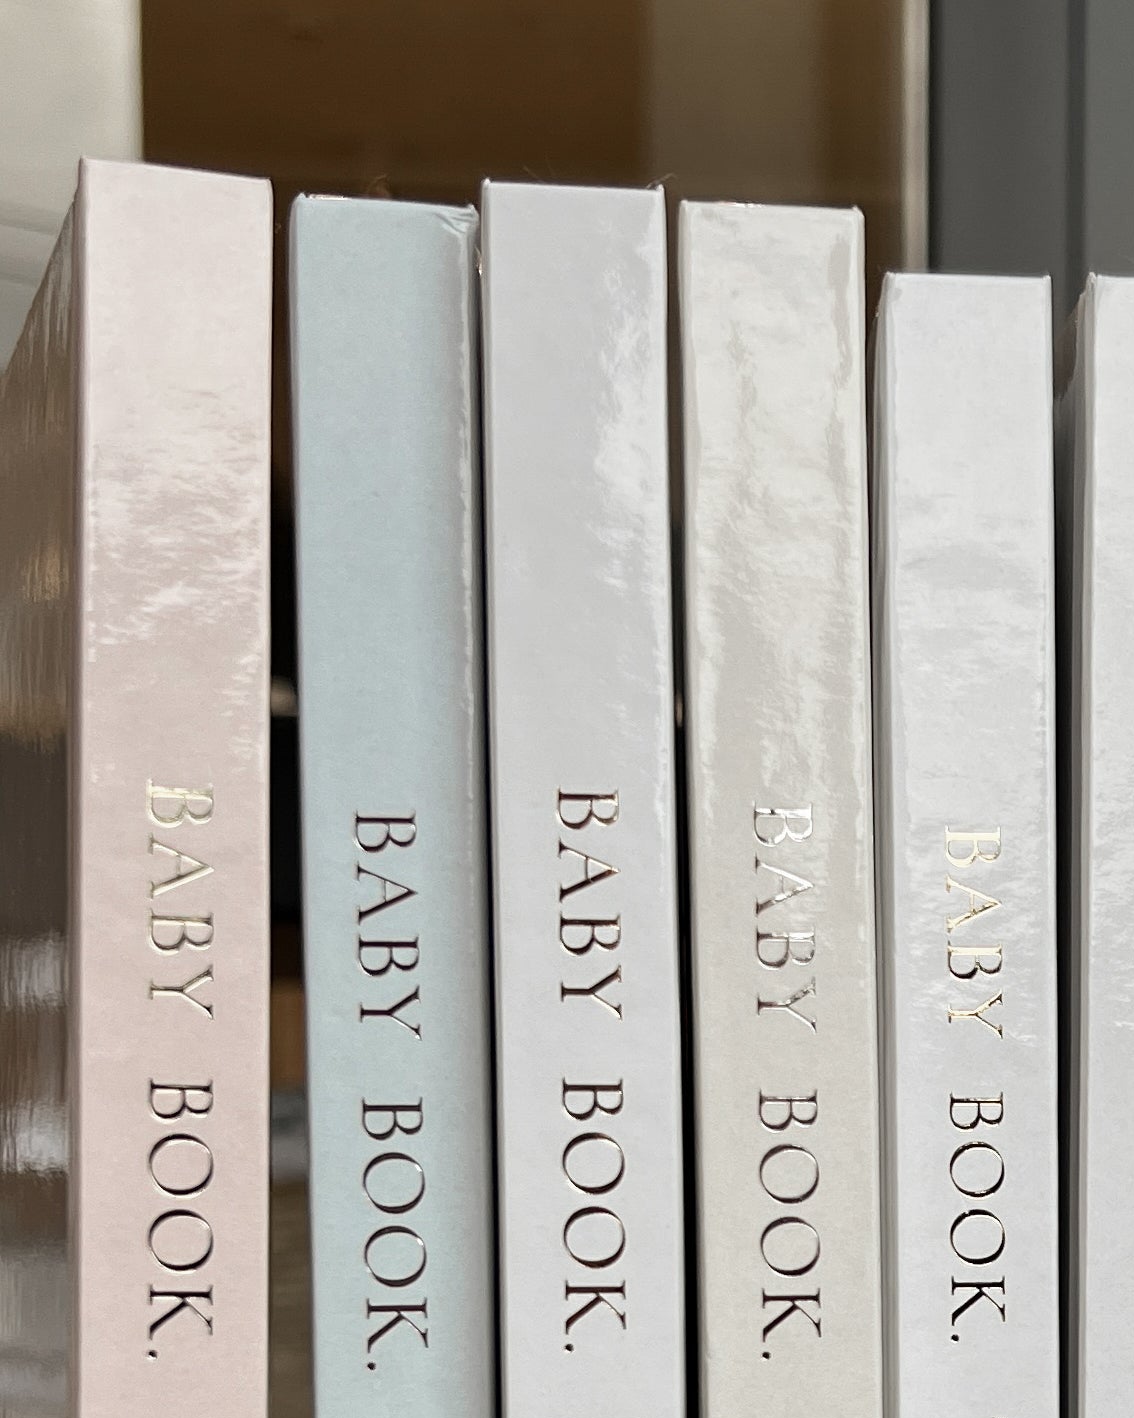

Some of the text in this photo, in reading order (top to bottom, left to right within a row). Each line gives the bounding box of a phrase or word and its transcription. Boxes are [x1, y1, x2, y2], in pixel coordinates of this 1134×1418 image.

[146, 778, 214, 1020] BABY
[353, 810, 422, 1040] BABY
[556, 786, 623, 1021] BABY
[752, 801, 817, 1034] BABY
[944, 825, 1004, 1040] BABY
[147, 1078, 214, 1360] BOOK.
[361, 1098, 429, 1371] BOOK.
[561, 1077, 627, 1352] BOOK.
[758, 1089, 822, 1360] BOOK.
[949, 1092, 1006, 1343] BOOK.
